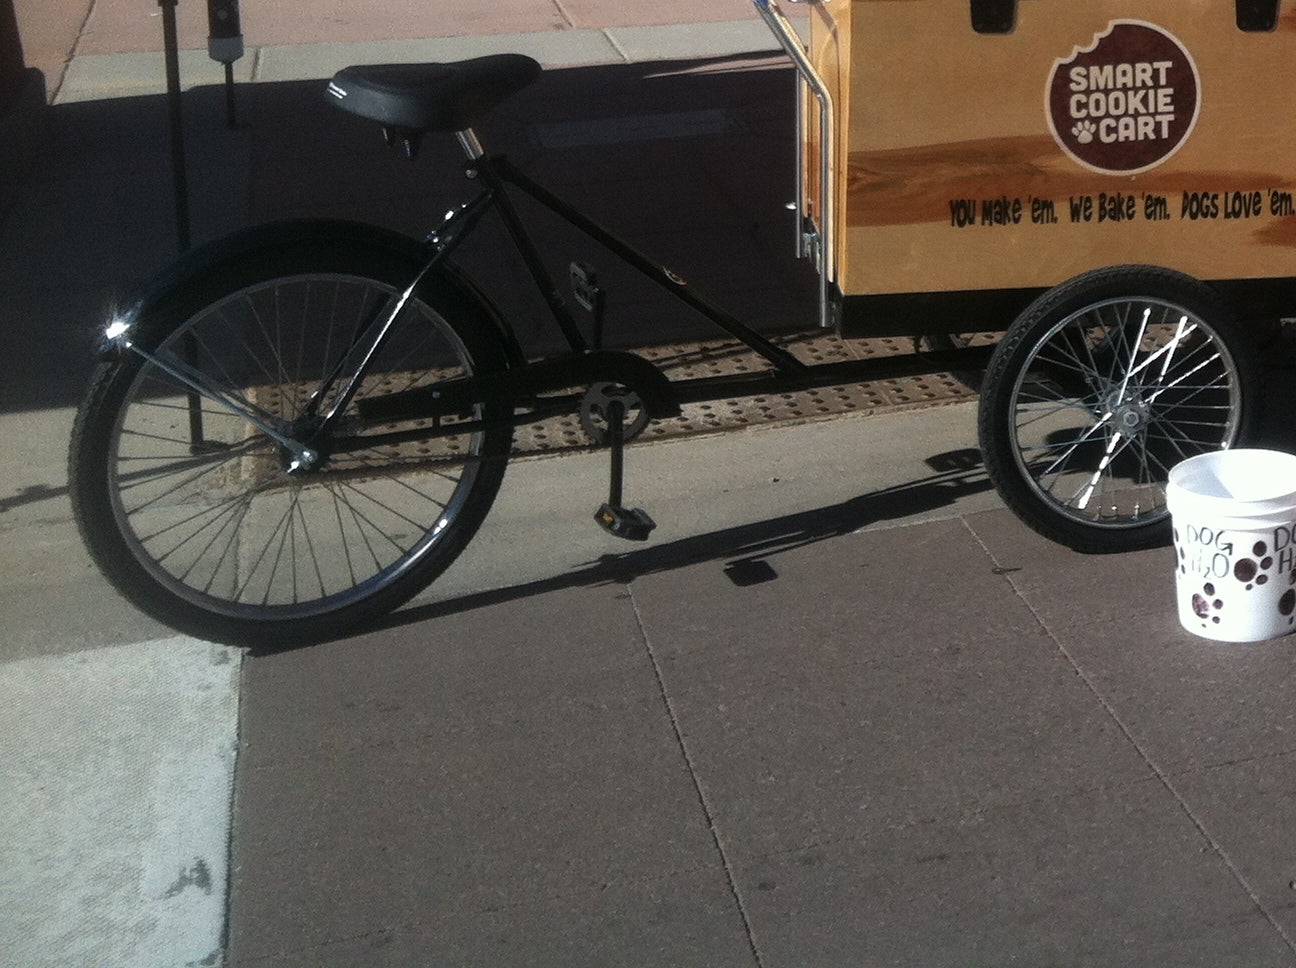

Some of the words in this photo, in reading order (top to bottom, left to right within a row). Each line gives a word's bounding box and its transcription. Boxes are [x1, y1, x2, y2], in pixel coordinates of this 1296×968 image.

[1069, 60, 1173, 92] SMART
[1069, 88, 1175, 119] COOKIE
[1099, 114, 1175, 144] CART
[1180, 190, 1219, 221] DOGS
[1187, 524, 1233, 556] DOG
